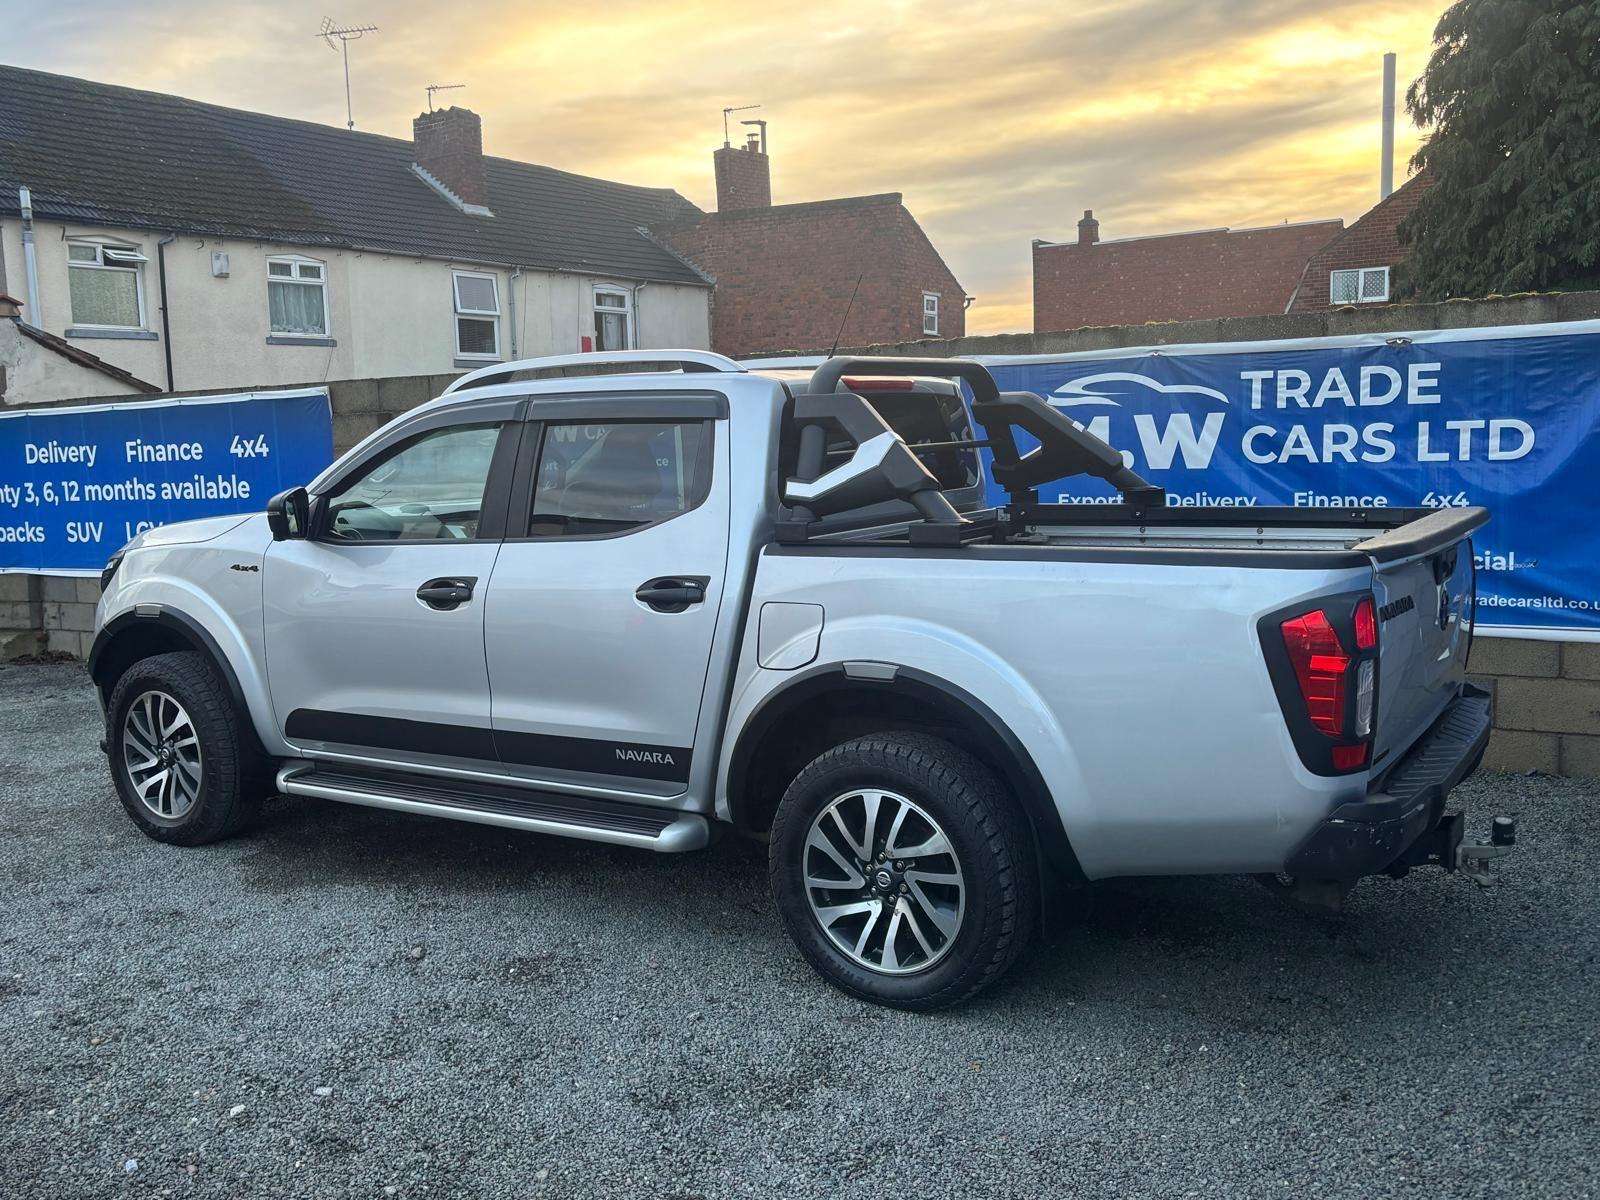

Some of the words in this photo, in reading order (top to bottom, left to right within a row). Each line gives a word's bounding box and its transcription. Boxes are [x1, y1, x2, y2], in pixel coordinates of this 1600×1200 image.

[1240, 362, 1441, 409] TRADE
[25, 441, 96, 467] Delivery
[126, 438, 203, 463] Finance
[229, 434, 269, 459] 4x4
[1241, 422, 1396, 463] CARS
[1417, 419, 1536, 463] LTD
[24, 482, 40, 506] 3,
[43, 481, 59, 506] 6,
[61, 480, 80, 502] 12
[84, 476, 155, 502] months
[161, 474, 250, 500] available
[1165, 491, 1257, 508] Delivery
[1293, 490, 1388, 508] Finance
[1420, 491, 1470, 509] 4x4
[66, 521, 103, 543] SUV
[615, 748, 675, 765] NAVARA
